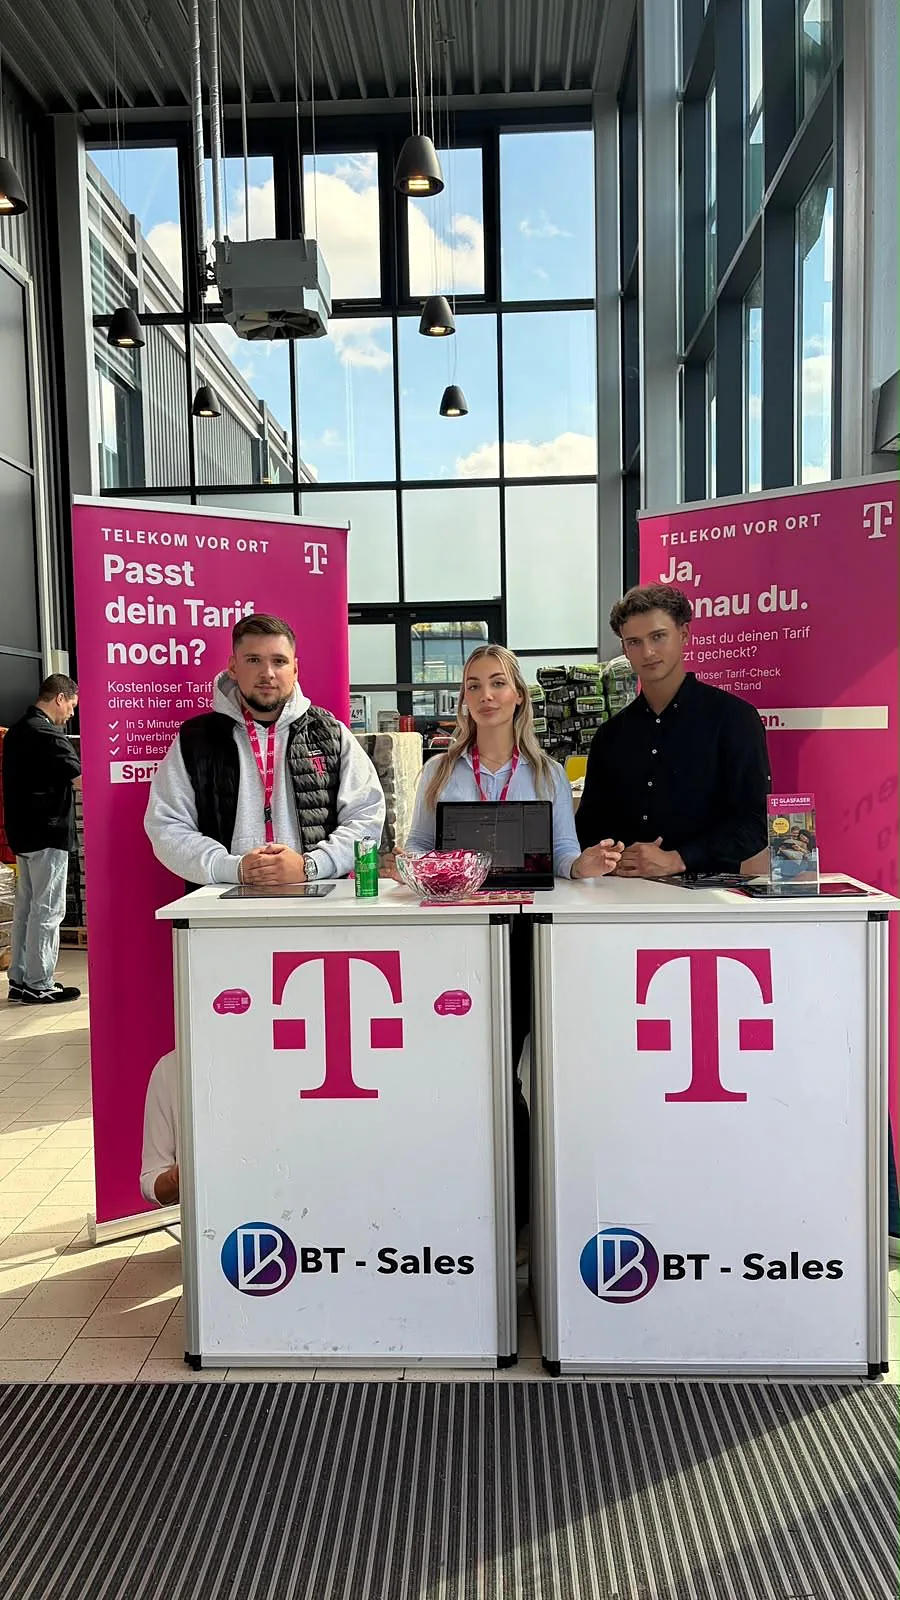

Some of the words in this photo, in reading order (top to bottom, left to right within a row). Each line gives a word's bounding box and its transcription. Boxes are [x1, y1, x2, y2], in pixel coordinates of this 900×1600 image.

[101, 527, 188, 547] TELEKOM
[195, 535, 229, 550] VOR
[236, 539, 269, 553] ORT
[660, 524, 736, 547] TELEKOM
[743, 519, 778, 536] VOR
[785, 513, 821, 530] ORT
[103, 553, 195, 587] Passt
[659, 556, 702, 587] Ja,
[105, 595, 177, 626] dein
[687, 593, 750, 619] nau
[757, 584, 809, 613] du.
[691, 634, 717, 646] hast
[719, 632, 734, 644] du
[737, 629, 779, 642] deinen
[782, 625, 811, 640] Tarif
[107, 637, 207, 666] noch?
[697, 645, 758, 663] gecheckt?
[107, 680, 182, 693] Kostenloser
[725, 667, 781, 679] Tarif-Check
[734, 681, 762, 691] Stand
[108, 697, 145, 709] direkt
[148, 697, 172, 709] hier
[175, 699, 194, 709] am
[126, 720, 135, 729] In
[138, 720, 144, 729] 5
[127, 745, 143, 755] Für
[272, 951, 403, 1099] T
[636, 949, 774, 1102] T
[301, 1247, 346, 1273] BT
[376, 1247, 475, 1275] Sales
[663, 1254, 710, 1280] BT
[742, 1251, 844, 1280] Sales
